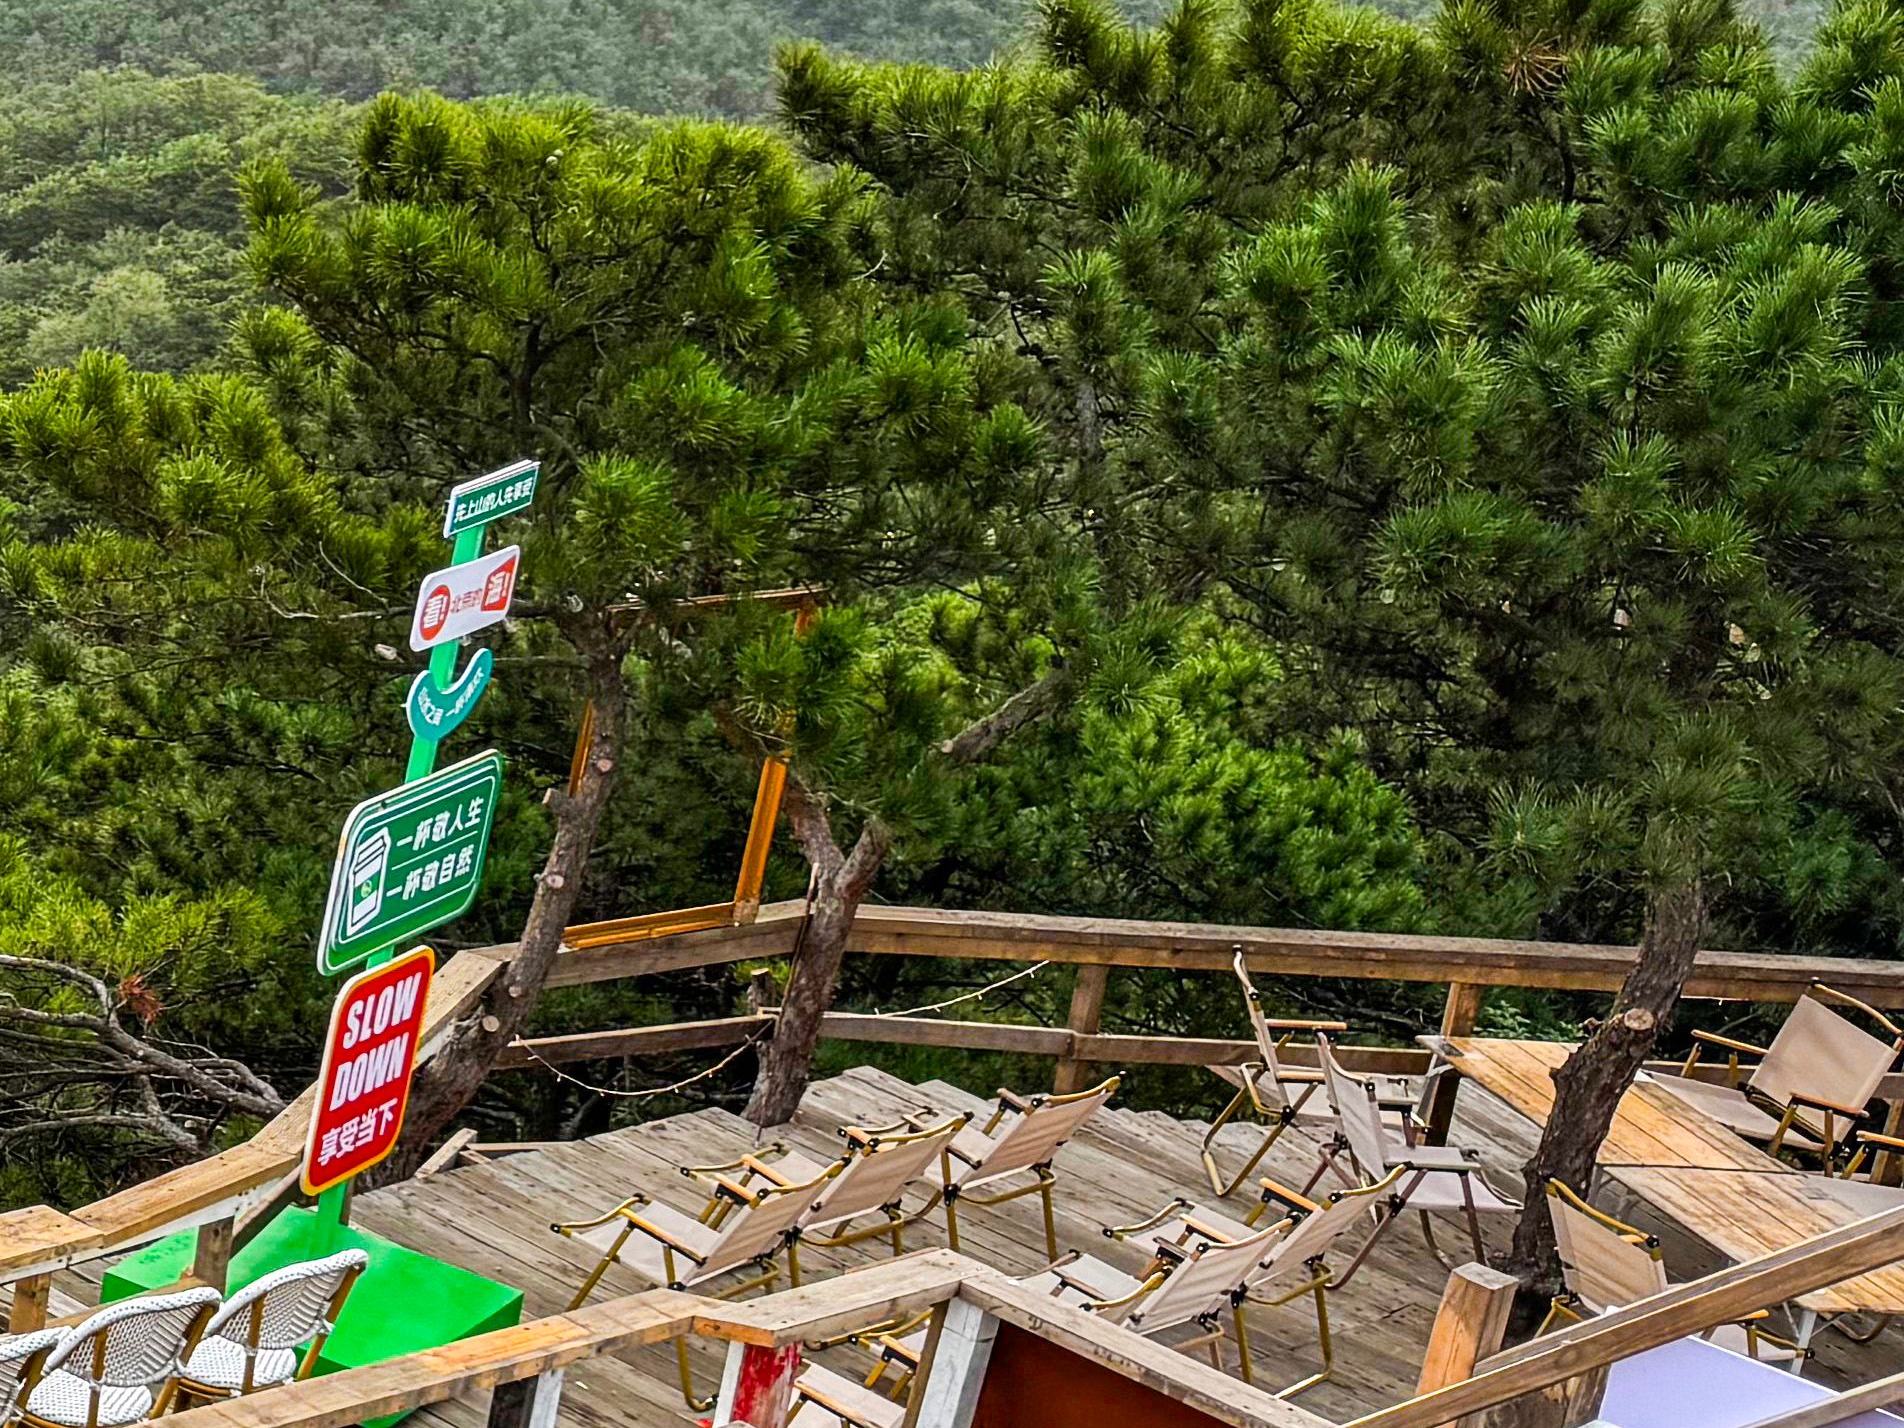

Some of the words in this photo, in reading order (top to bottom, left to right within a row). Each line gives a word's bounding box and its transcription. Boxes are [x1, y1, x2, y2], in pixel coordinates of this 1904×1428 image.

[396, 797, 484, 853] 一杯敬人生
[386, 844, 475, 901] 一杯敬自然
[342, 972, 423, 1051] SLOW
[329, 1032, 410, 1112] DOWN
[317, 1098, 398, 1167] 享受当下
